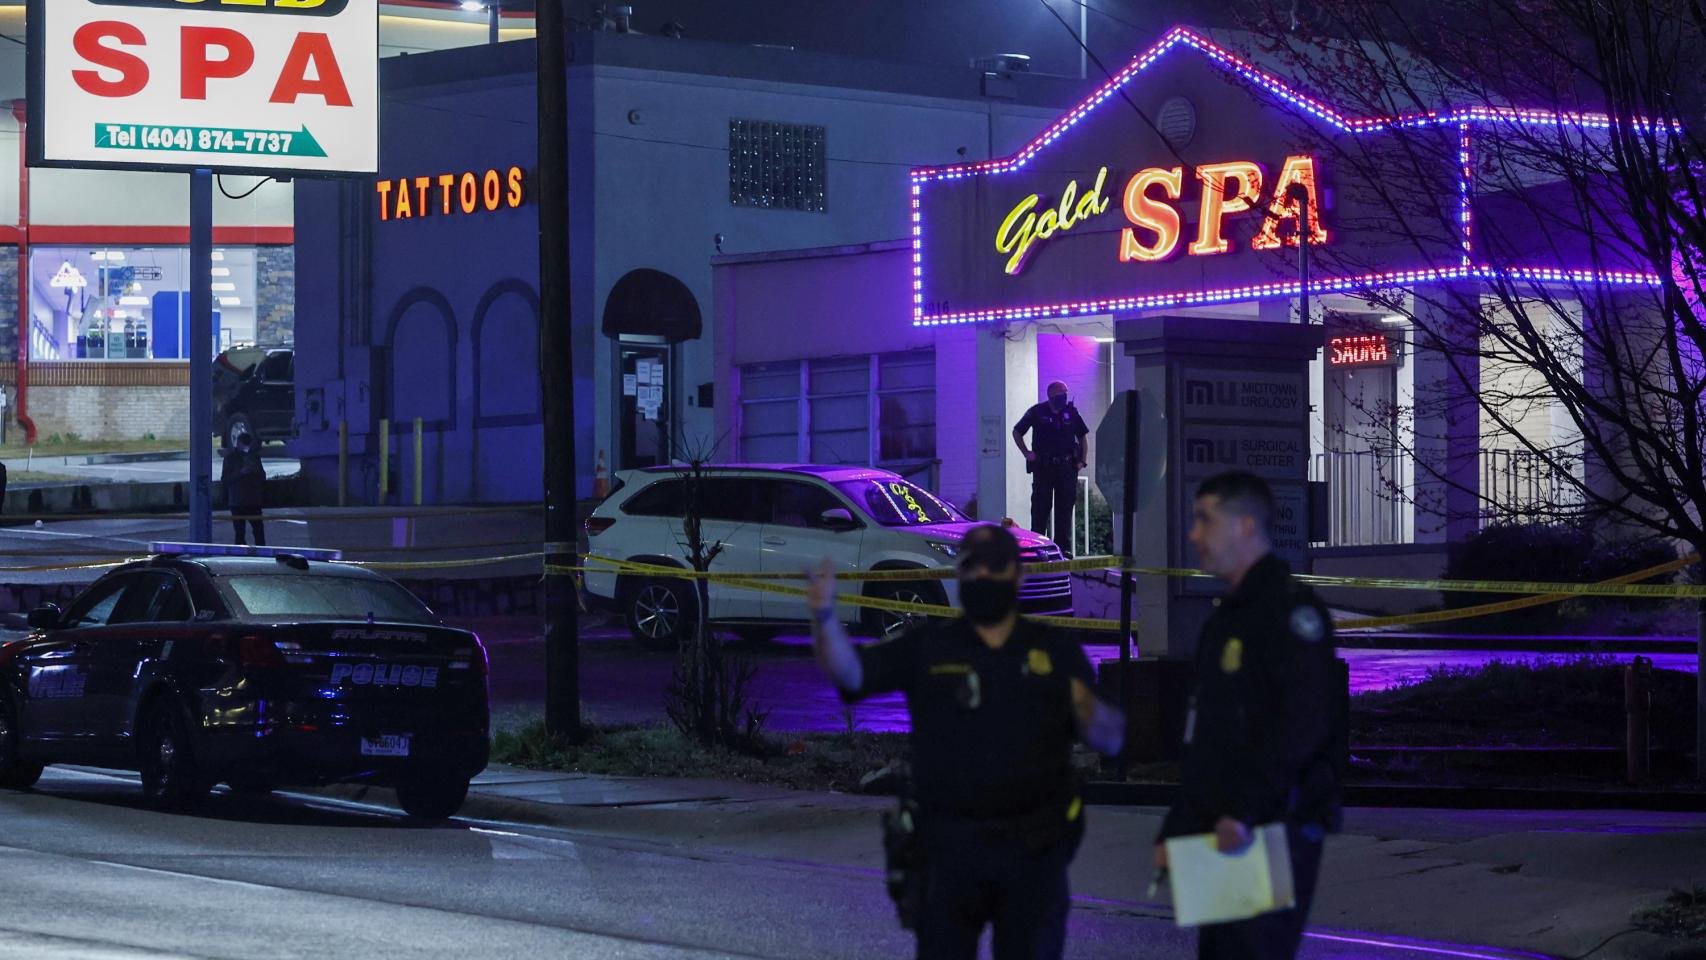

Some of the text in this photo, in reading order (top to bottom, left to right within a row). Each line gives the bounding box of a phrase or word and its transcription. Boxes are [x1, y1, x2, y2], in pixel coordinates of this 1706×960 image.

[71, 20, 354, 108] SPA
[106, 125, 293, 153] Tel (404) 874-7737
[376, 165, 524, 222] TATTOOS
[994, 154, 1329, 276] Gold SPA
[1330, 336, 1388, 364] SAUNA
[1241, 383, 1297, 395] MIDTOWN
[1241, 396, 1298, 408] UROLOGY
[1241, 440, 1300, 453] SURGICAL
[1246, 455, 1295, 467] CENTER
[1271, 536, 1304, 550] RAFFIC
[329, 662, 440, 688] POLICE
